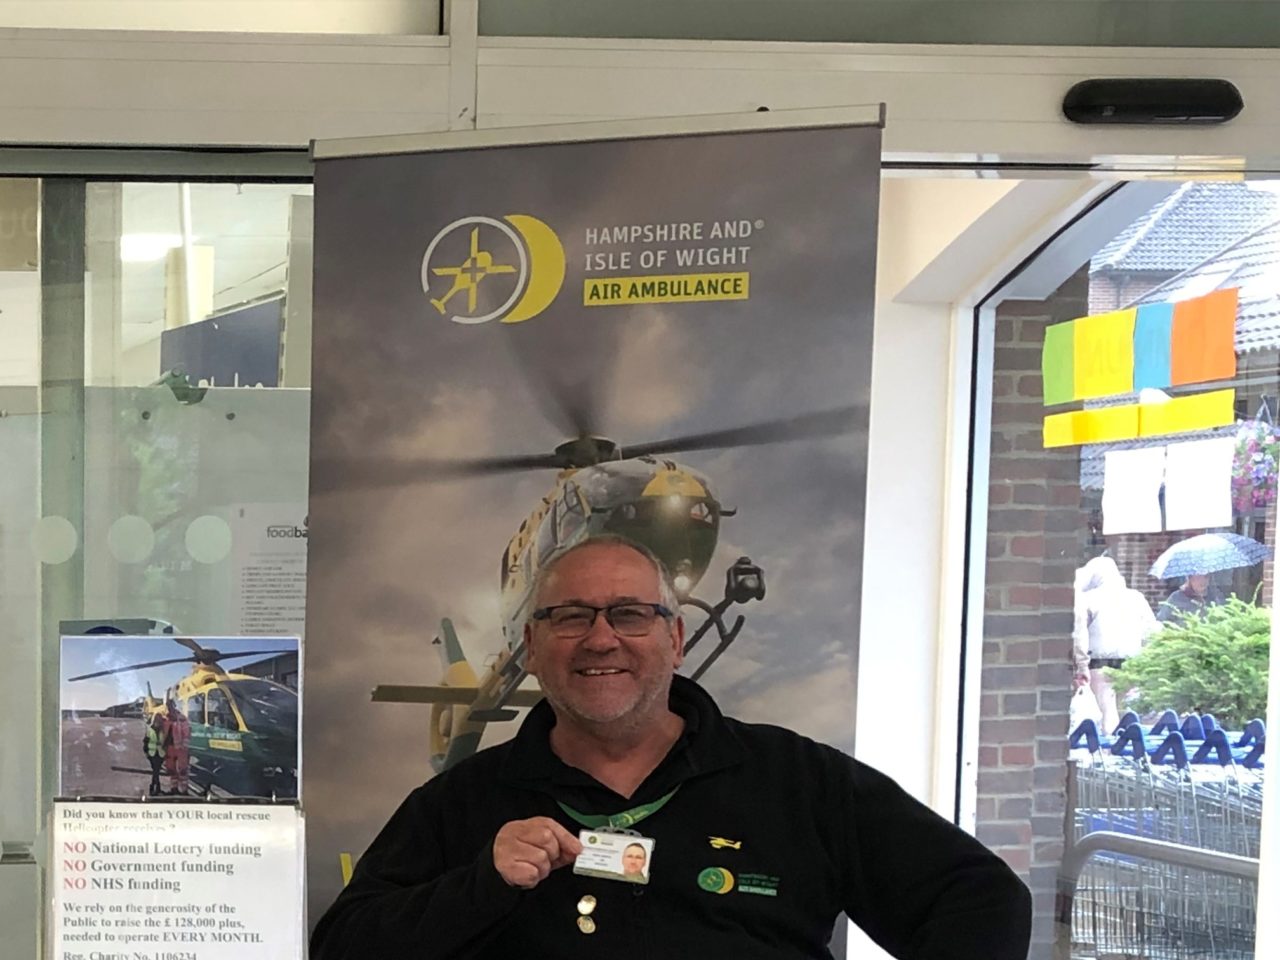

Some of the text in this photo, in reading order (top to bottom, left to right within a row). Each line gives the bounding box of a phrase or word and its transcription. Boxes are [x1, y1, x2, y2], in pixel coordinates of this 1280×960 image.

[585, 221, 702, 245] HAMPSHIRE
[585, 246, 751, 271] ISLE OF WIGHT
[589, 277, 743, 301] AIR AMBULANCE
[266, 526, 309, 538] foodba
[63, 809, 271, 822] Did you know that YOUR local rescue
[63, 841, 262, 858] NO National Lottery funding
[63, 860, 234, 876] NO Government funding
[63, 877, 181, 893] NO NHS funding
[63, 902, 237, 917] We rely on the generosity of the
[63, 916, 245, 931] Public to raise the £ 128,000 plus,
[63, 931, 264, 945] needed to operate EVERY MONTH.
